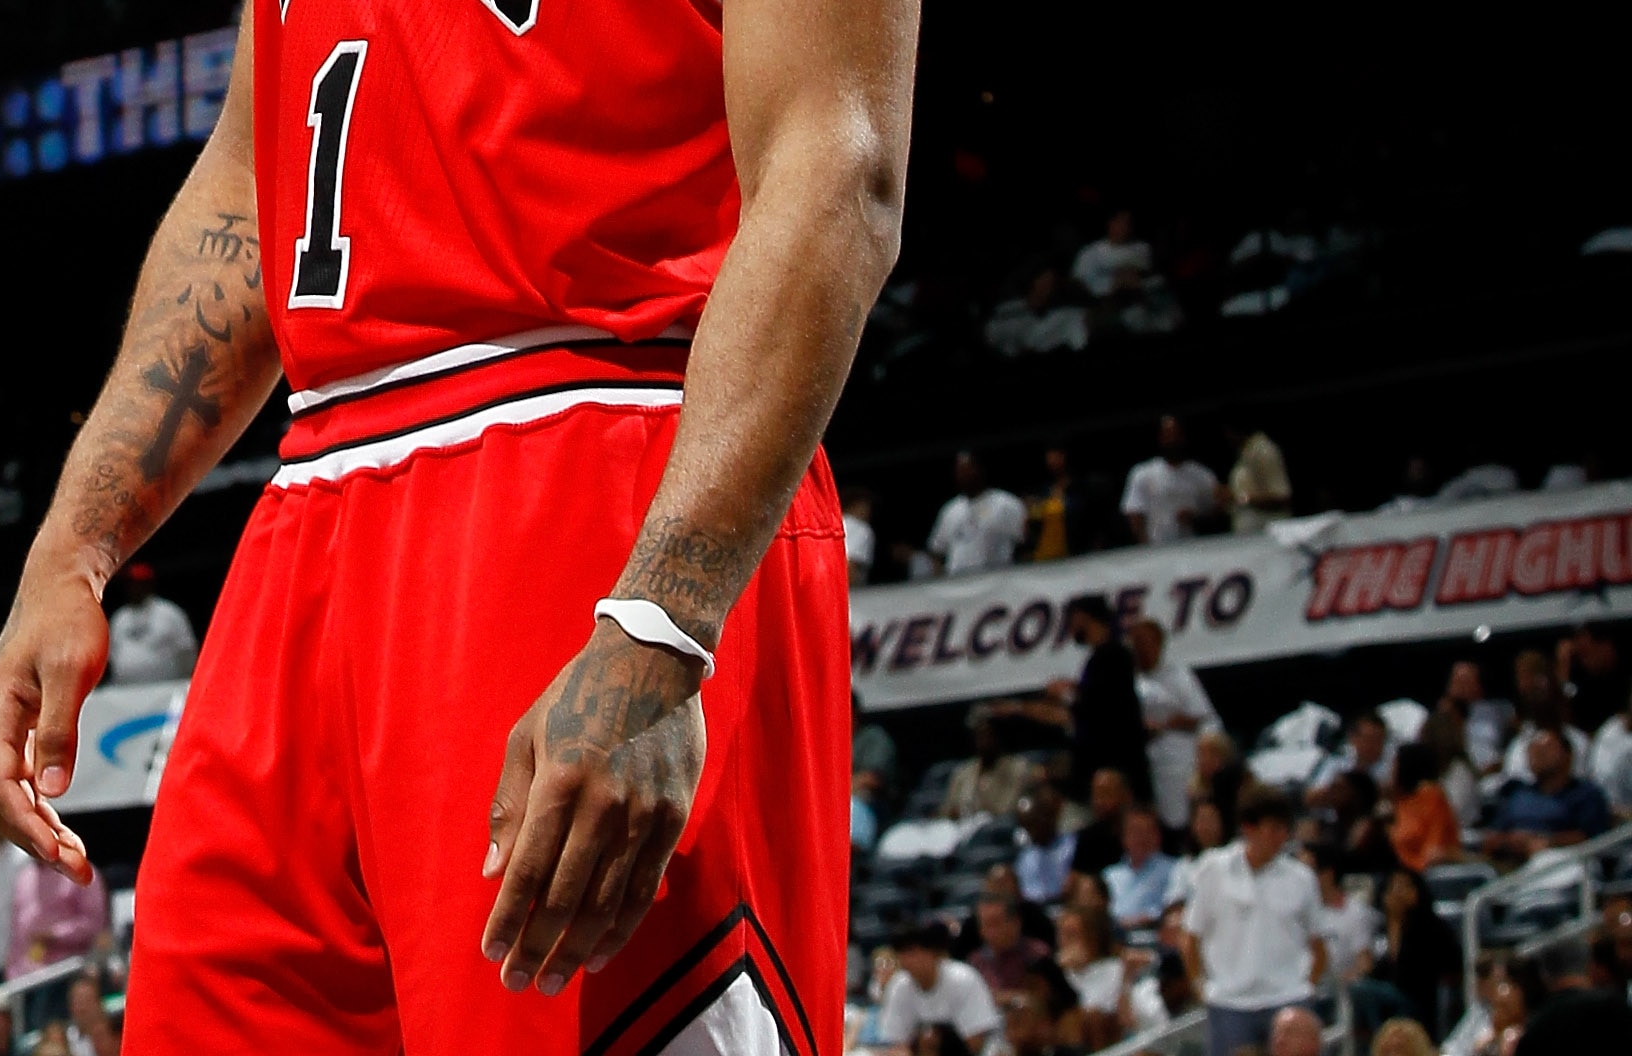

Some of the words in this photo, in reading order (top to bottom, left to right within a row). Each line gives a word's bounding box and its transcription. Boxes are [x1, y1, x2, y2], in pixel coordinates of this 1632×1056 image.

[60, 24, 239, 164] THE
[287, 40, 368, 309] 1
[1172, 570, 1254, 632] TO
[1305, 538, 1437, 623] THE
[1435, 514, 1632, 605] HIGHL
